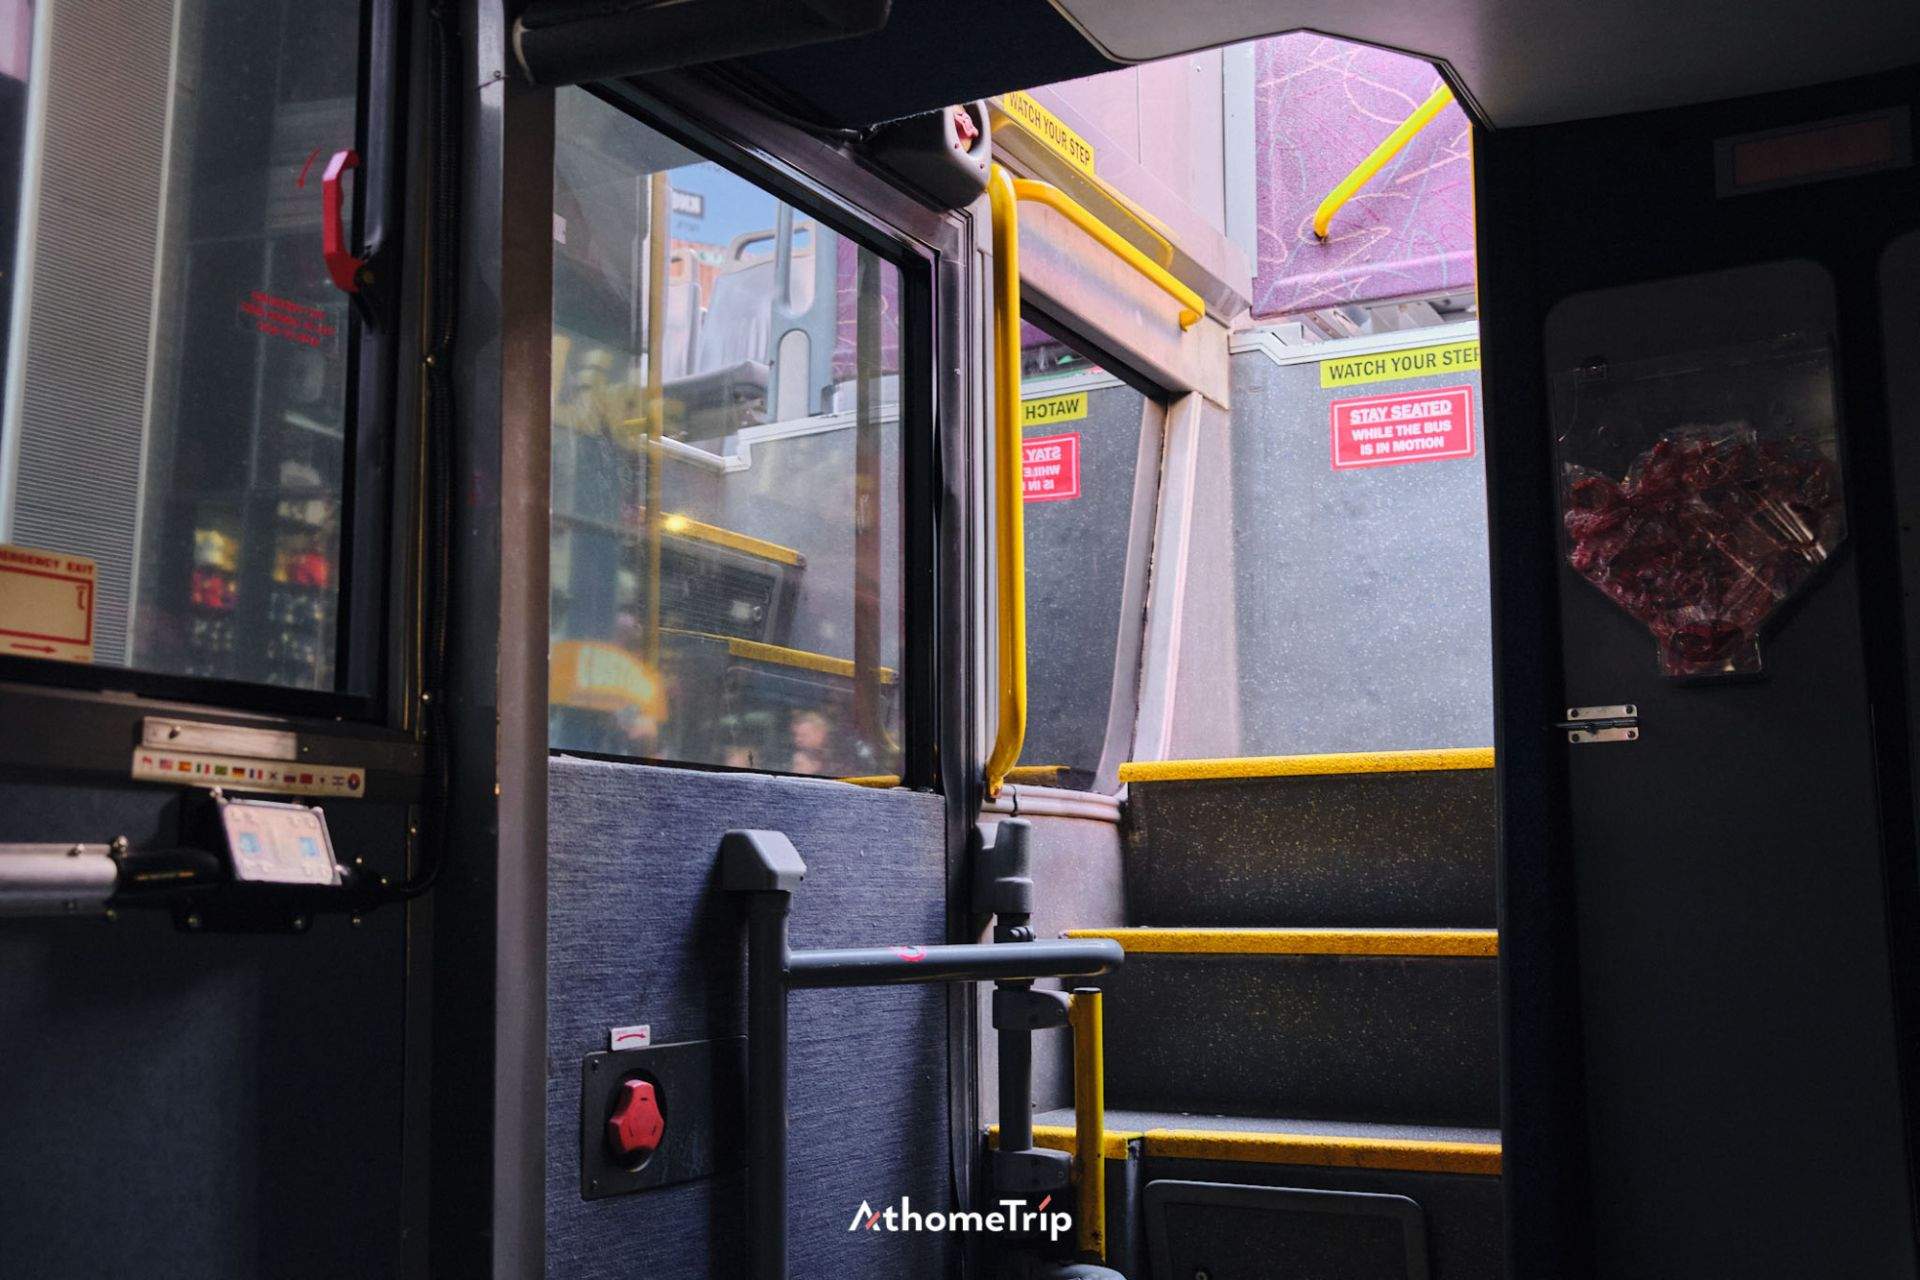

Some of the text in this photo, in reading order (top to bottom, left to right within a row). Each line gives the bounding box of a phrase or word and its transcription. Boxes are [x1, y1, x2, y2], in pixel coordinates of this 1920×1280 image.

[1009, 92, 1091, 165] WATCH YOUR STEP
[1329, 359, 1386, 380] WATCH
[1392, 353, 1437, 372] YOUR
[1350, 399, 1453, 424] STAY SEATED
[1351, 420, 1452, 441] WHILE THE BUS
[1360, 436, 1444, 456] IS IN MOTION
